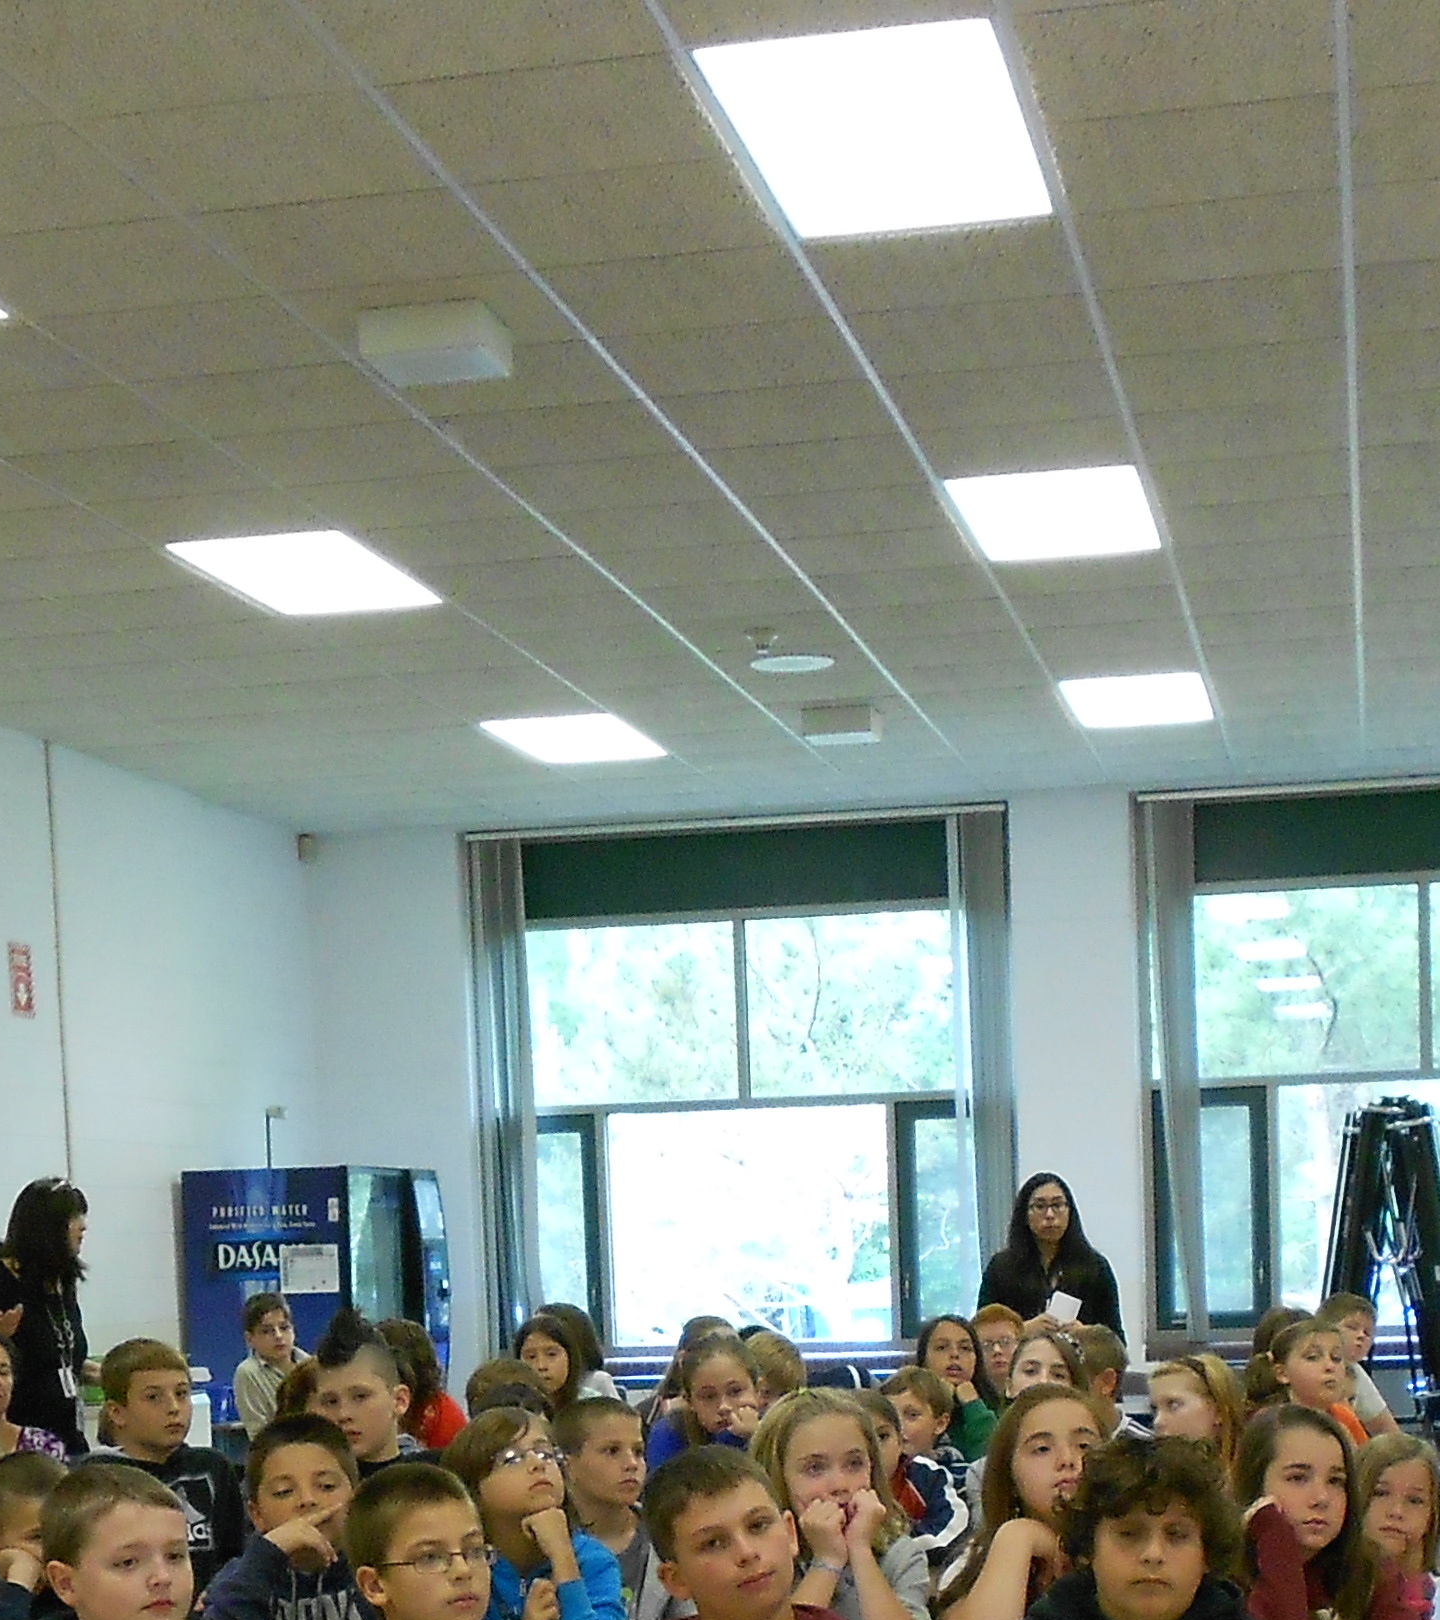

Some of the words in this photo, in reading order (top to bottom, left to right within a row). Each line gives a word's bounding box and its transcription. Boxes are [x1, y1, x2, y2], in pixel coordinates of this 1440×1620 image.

[211, 1206, 265, 1218] PURIFIED
[271, 1204, 308, 1217] WATER
[217, 1241, 304, 1271] DASA
